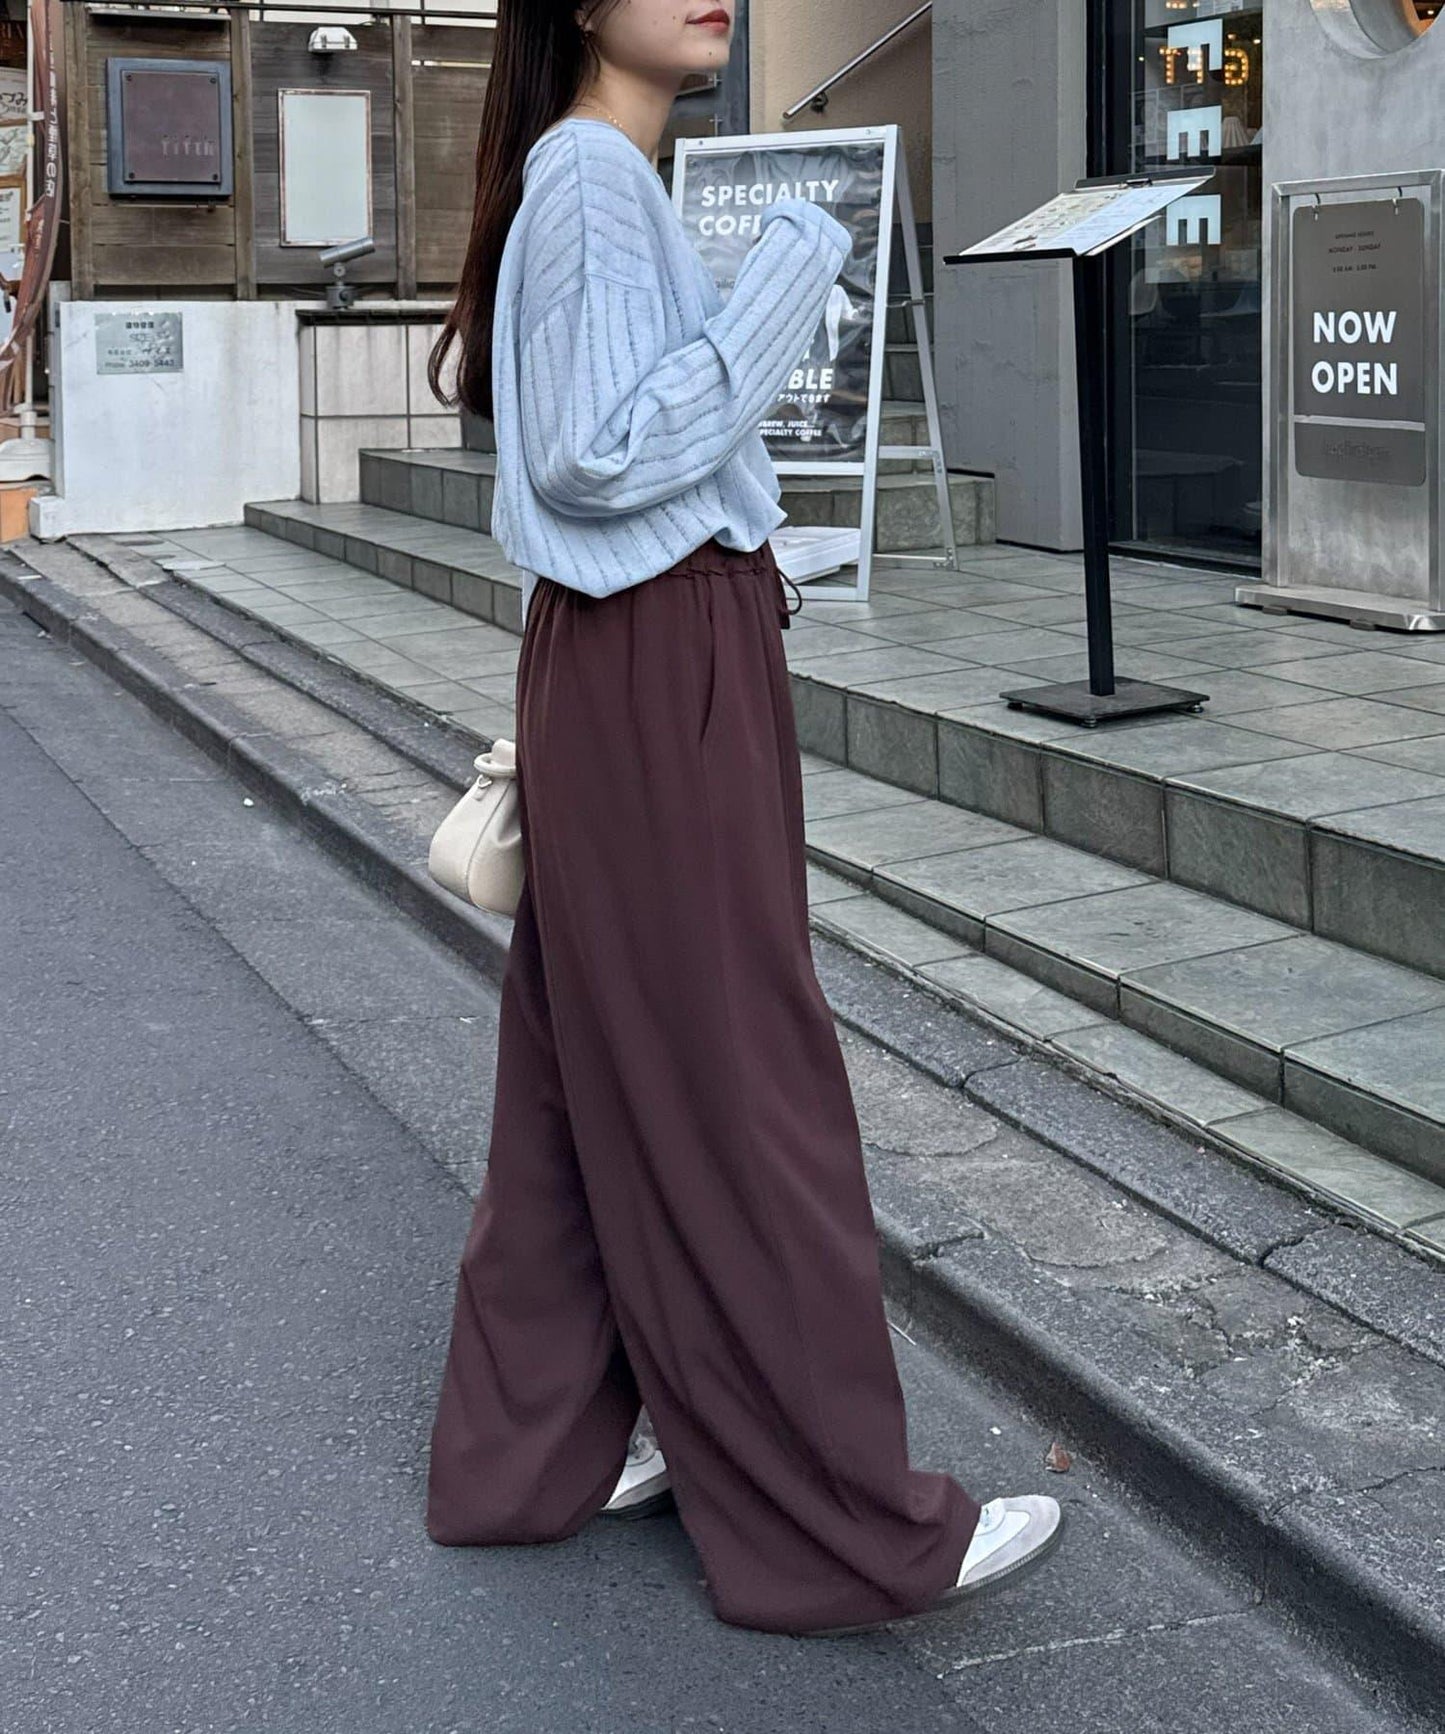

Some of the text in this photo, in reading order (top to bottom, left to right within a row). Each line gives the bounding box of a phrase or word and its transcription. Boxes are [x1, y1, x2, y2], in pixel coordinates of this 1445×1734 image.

[701, 179, 839, 207] SPECIALTY
[698, 214, 762, 236] COFF
[1313, 310, 1397, 344] NOW
[787, 368, 834, 390] BLE
[1311, 361, 1398, 395] OPEN
[759, 429, 793, 437] PECIALTY
